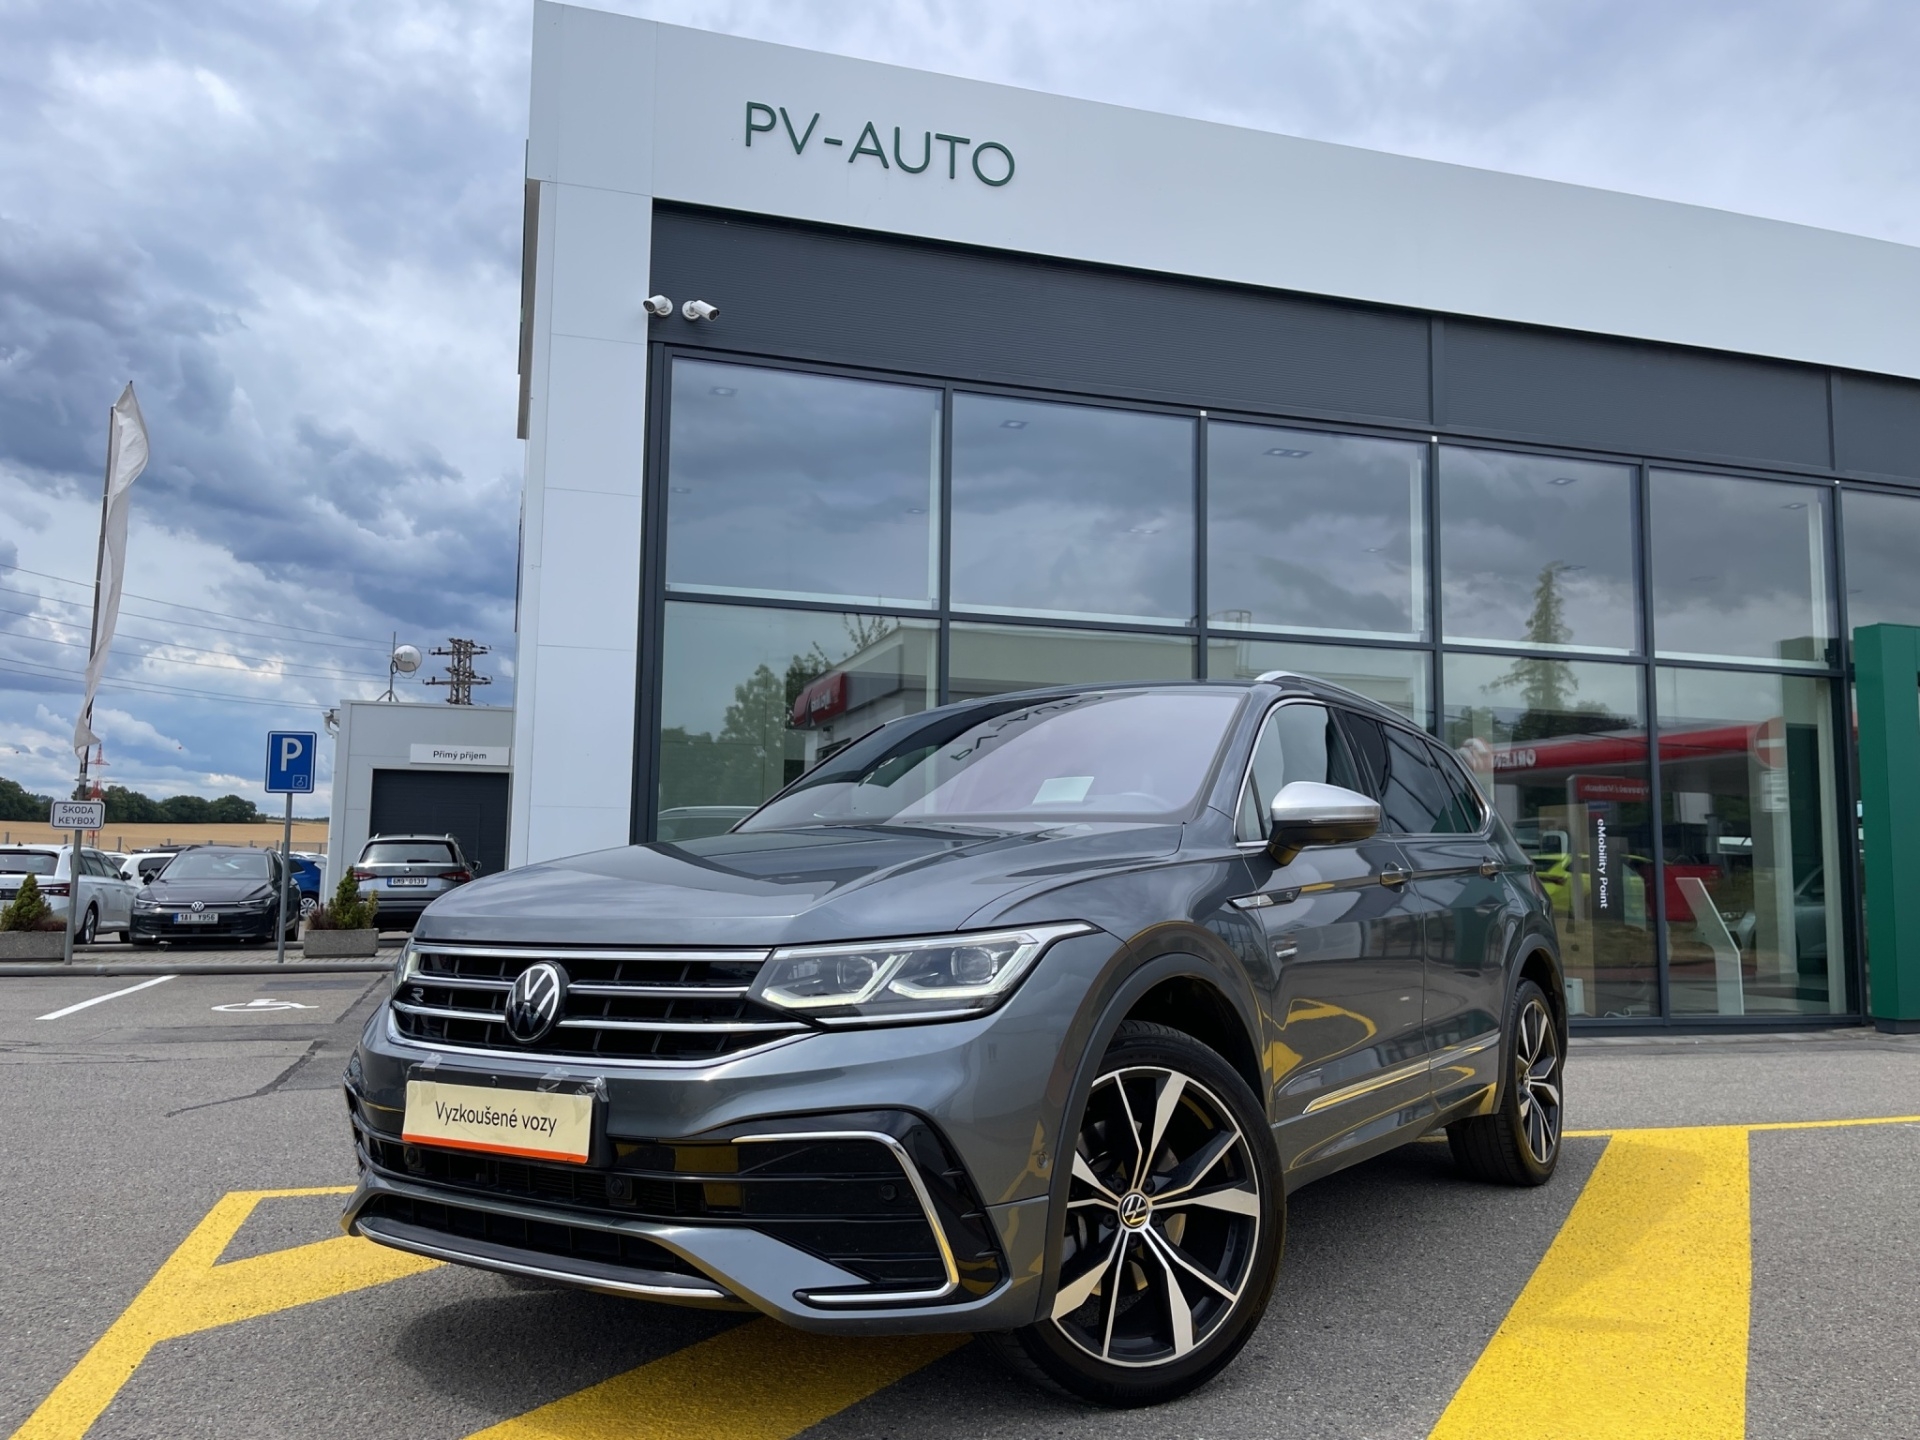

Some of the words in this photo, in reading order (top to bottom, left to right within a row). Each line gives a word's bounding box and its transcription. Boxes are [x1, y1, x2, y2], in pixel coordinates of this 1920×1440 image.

[745, 101, 1015, 187] PV-AUTO
[280, 737, 303, 772] P
[433, 750, 458, 760] Přímý
[460, 751, 487, 761] příjem
[58, 816, 96, 825] KEYBOX
[62, 804, 94, 814] ŠKODA
[1597, 818, 1608, 874] eMobility
[1599, 877, 1609, 909] Point
[435, 1100, 518, 1128] Vyzkoušené
[522, 1115, 557, 1137] vozy
